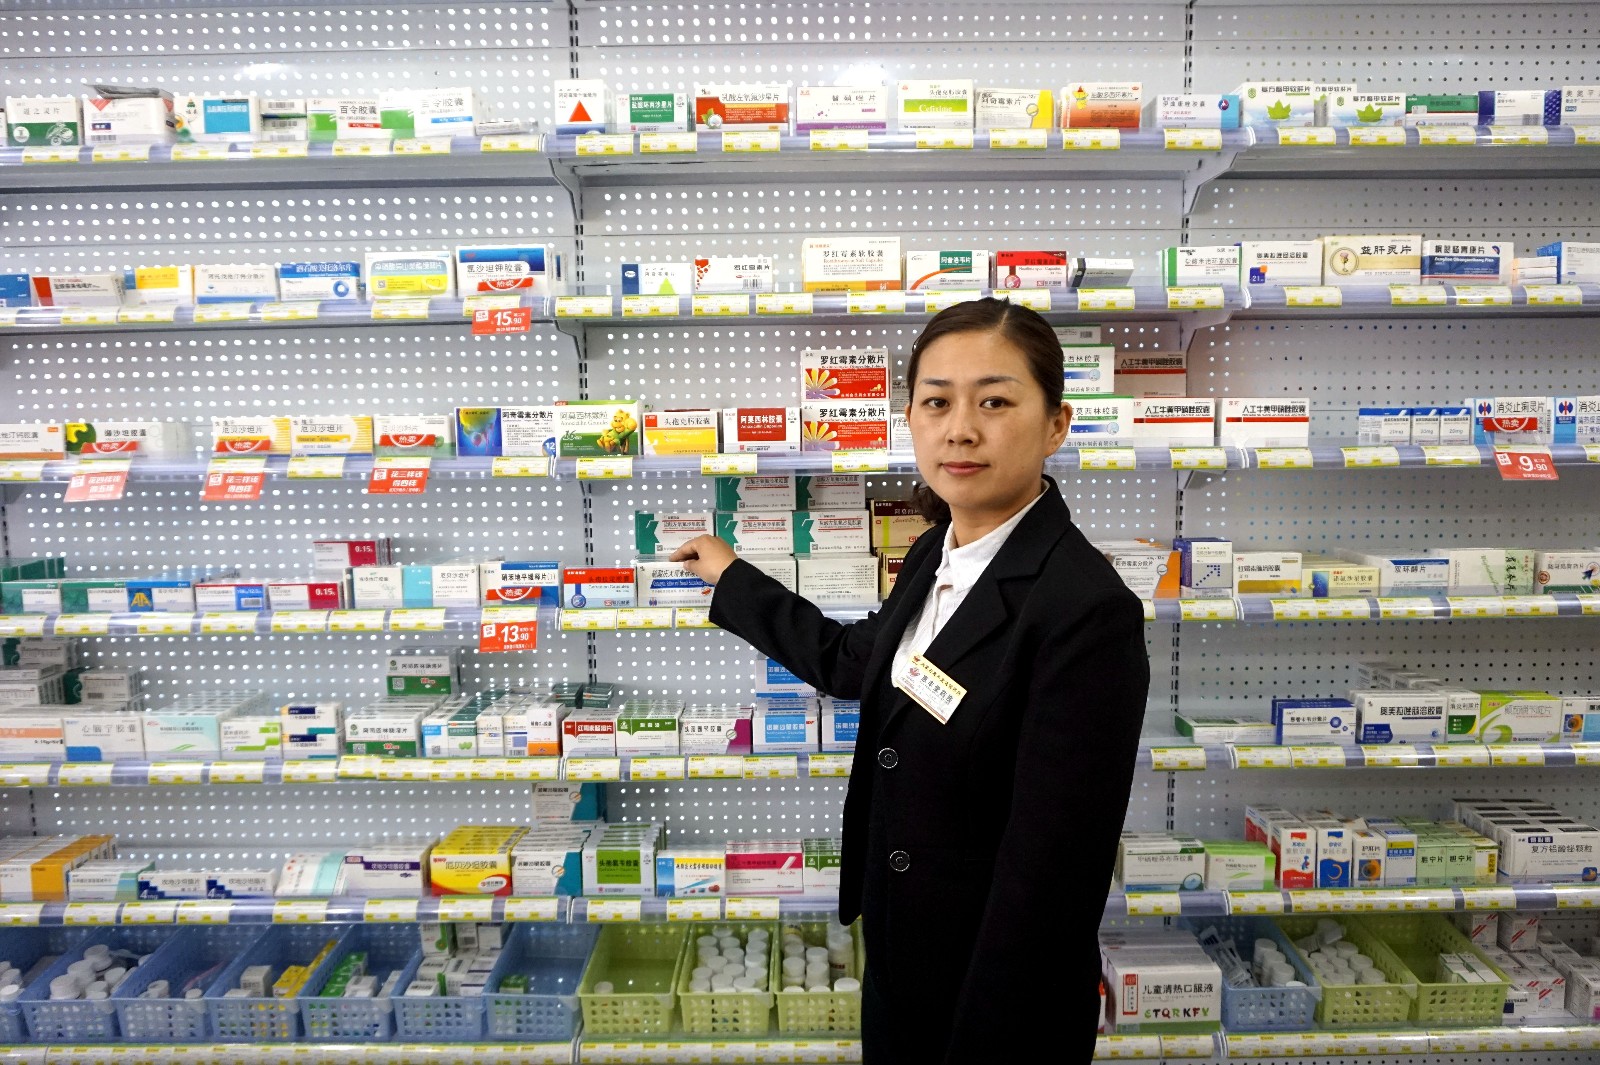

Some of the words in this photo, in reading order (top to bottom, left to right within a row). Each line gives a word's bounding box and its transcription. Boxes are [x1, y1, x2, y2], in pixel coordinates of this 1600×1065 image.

[340, 105, 377, 114] 百令胶囊
[1360, 245, 1412, 255] 益肝灵片
[820, 355, 886, 365] 罗红霉素分散片
[1063, 355, 1100, 363] 西林胶囊
[1145, 405, 1211, 414] 人工牛黄甲硝唑胶囊
[1242, 405, 1306, 414] 人工牛黄甲硝唑胶囊
[1496, 401, 1546, 413] 消炎止痢灵片
[502, 411, 553, 419] 阿奇霉素分散片
[819, 408, 886, 418] 罗红霉素分散片
[740, 415, 783, 424] 阿莫西林胶囊
[1502, 419, 1519, 428] 热卖
[1532, 844, 1593, 853] 复方铝酸铋颗粒
[1142, 983, 1214, 995] 儿童清热口服液
